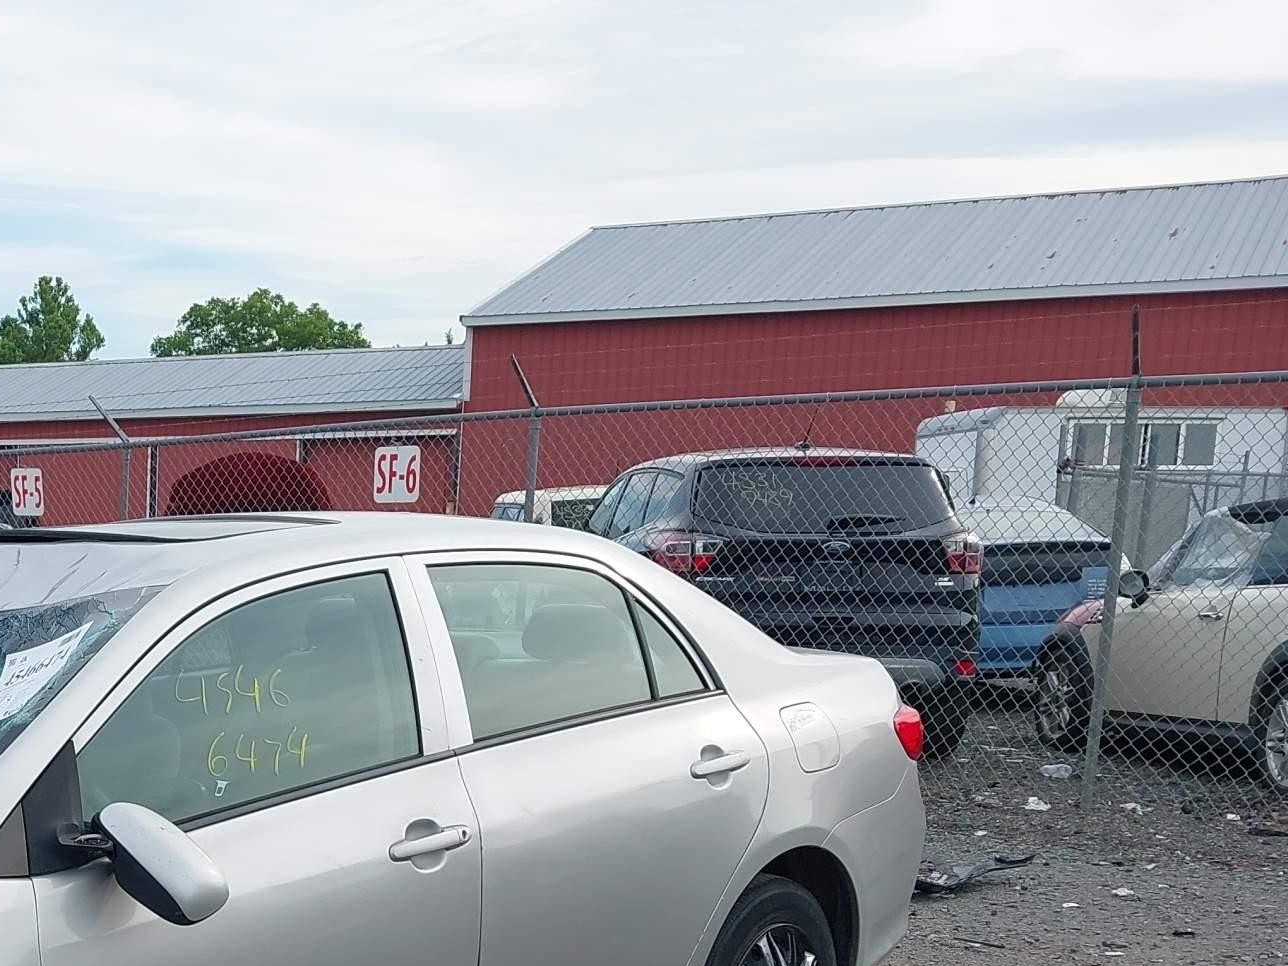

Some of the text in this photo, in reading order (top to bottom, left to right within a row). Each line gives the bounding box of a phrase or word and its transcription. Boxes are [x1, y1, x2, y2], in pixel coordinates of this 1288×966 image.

[14, 475, 42, 509] SF-5
[376, 454, 416, 494] SF-6
[175, 664, 292, 716] 4546
[207, 725, 309, 777] 6474
